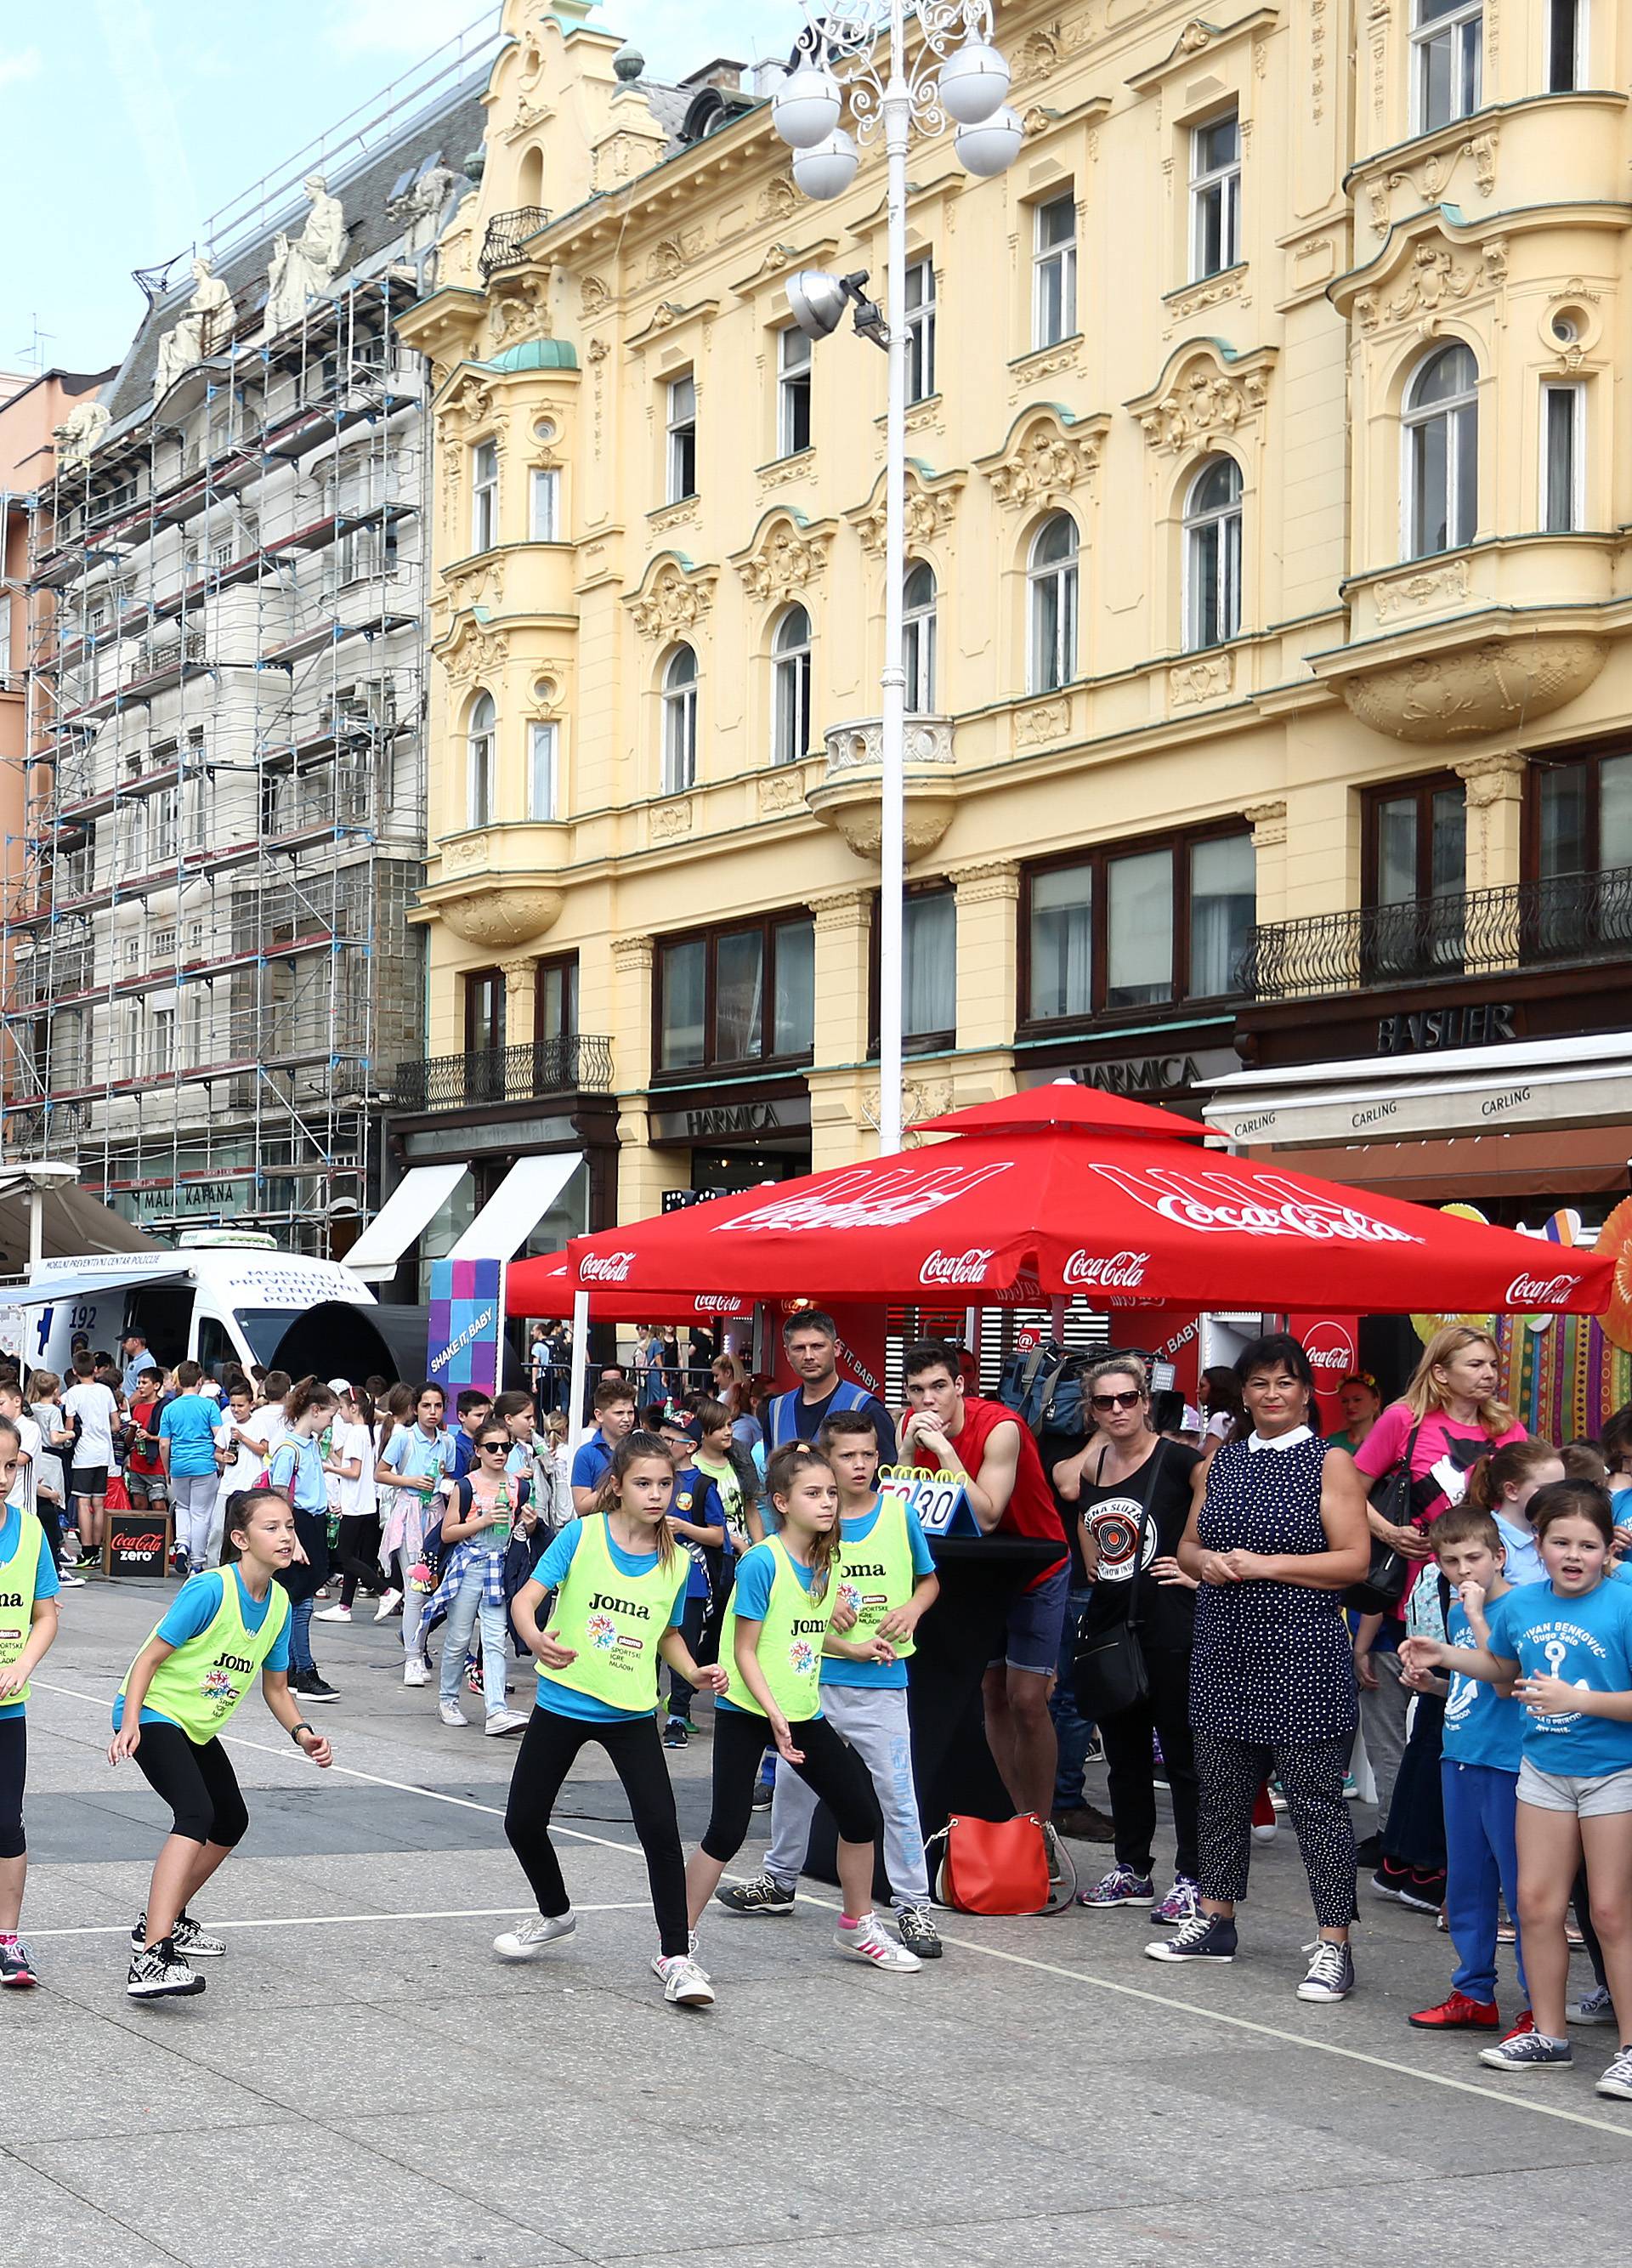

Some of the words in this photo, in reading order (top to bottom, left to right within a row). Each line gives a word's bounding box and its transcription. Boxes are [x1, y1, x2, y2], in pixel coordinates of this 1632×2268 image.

[1377, 1004, 1516, 1052] BASLER
[1069, 1057, 1202, 1093] HARMICA
[1352, 1101, 1397, 1128] CARLING
[1482, 1087, 1531, 1116] CARLING
[686, 1103, 779, 1136] HARMICA
[1234, 1112, 1277, 1137] CARLING
[144, 1191, 178, 1209] MALA
[1156, 1194, 1427, 1243] Coca-Cola
[45, 1261, 69, 1270] MOBILNI
[107, 1256, 131, 1267] CENTAR
[131, 1255, 161, 1265] POLICIJE
[247, 1271, 332, 1280] MOBILNI
[580, 1252, 636, 1282] Coca-Cola
[920, 1249, 994, 1284] Coca-Cola
[1062, 1249, 1150, 1287] Coca-Cola
[230, 1279, 360, 1294] PREVENTIVNI
[264, 1286, 341, 1297] CENTAR
[69, 1306, 97, 1330] 192
[431, 1339, 460, 1373] SHAKE
[459, 1330, 469, 1347] IT,
[468, 1307, 492, 1338] BABY
[1167, 1318, 1199, 1353] BABY
[853, 1359, 880, 1392] BABY
[917, 1489, 953, 1524] 30
[110, 1533, 164, 1551] Coca-Cola
[120, 1551, 153, 1562] zero
[1533, 1633, 1556, 1644] Dugo
[1558, 1632, 1579, 1647] Selo
[213, 1653, 254, 1674] Jom
[1552, 1712, 1582, 1726] PRIROD
